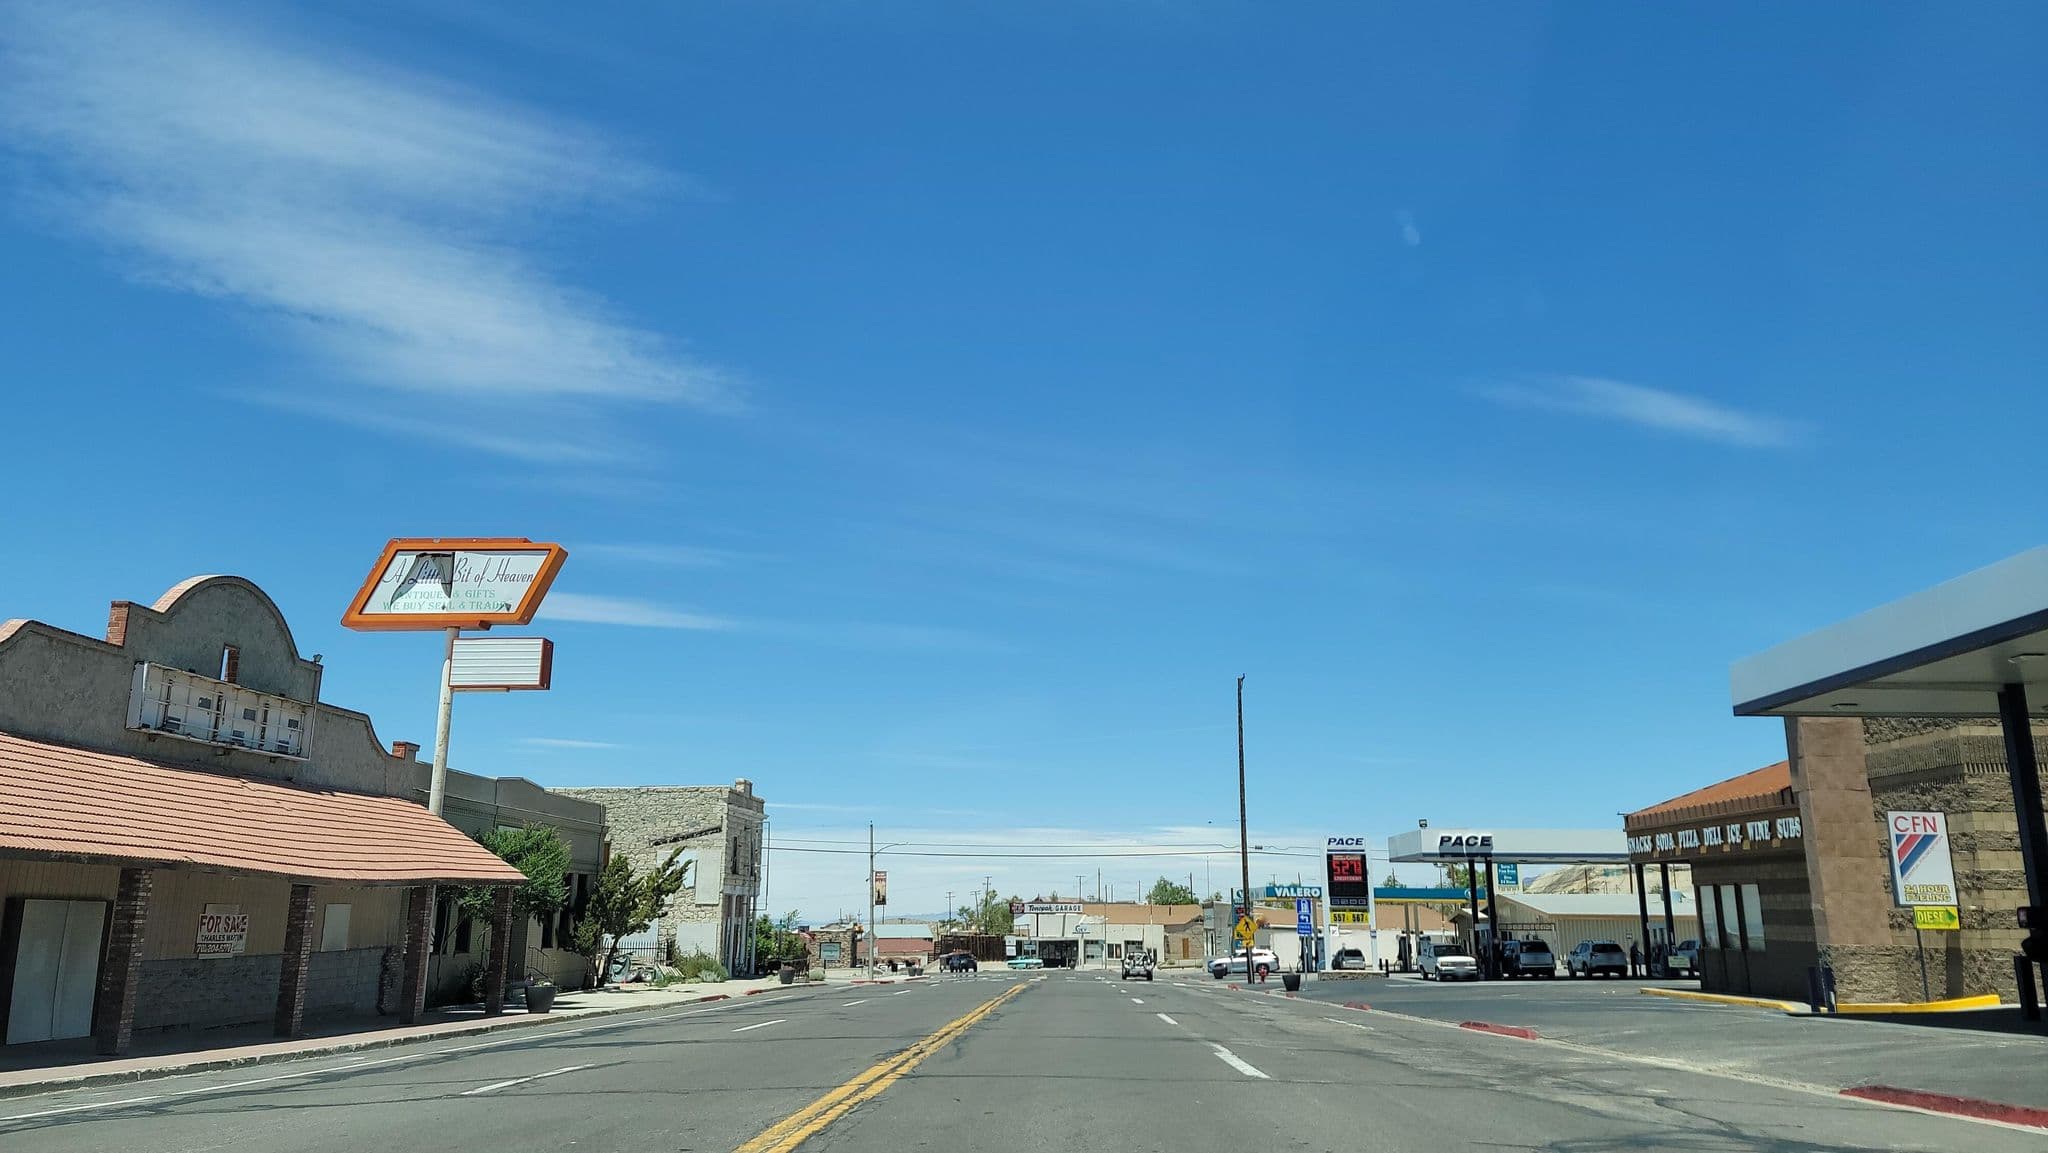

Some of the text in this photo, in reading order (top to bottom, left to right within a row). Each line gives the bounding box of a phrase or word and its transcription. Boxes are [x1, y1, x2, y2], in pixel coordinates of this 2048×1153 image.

[383, 558, 408, 583] A
[453, 557, 471, 583] Bit
[474, 558, 489, 588] of
[487, 557, 534, 584] Heaven
[397, 591, 447, 600] ANTIQUE
[465, 589, 496, 598] GIFTS
[383, 601, 400, 611] WE
[403, 601, 426, 611] BUY
[469, 601, 504, 611] TRAD
[1893, 815, 1938, 833] CFN
[1628, 816, 1802, 854] SNACKS SODA PIZZA DELI ICE WINE SUBS
[1327, 837, 1364, 846] PACE
[1439, 835, 1493, 847] PACE
[1274, 887, 1321, 897] VALERO
[1919, 884, 1951, 894] HOUR
[1905, 893, 1952, 902] FUELING
[1055, 904, 1081, 912] GARAGE
[1917, 910, 1947, 923] DIESE
[200, 914, 248, 933] FOR SALE
[201, 934, 225, 942] CHARLES
